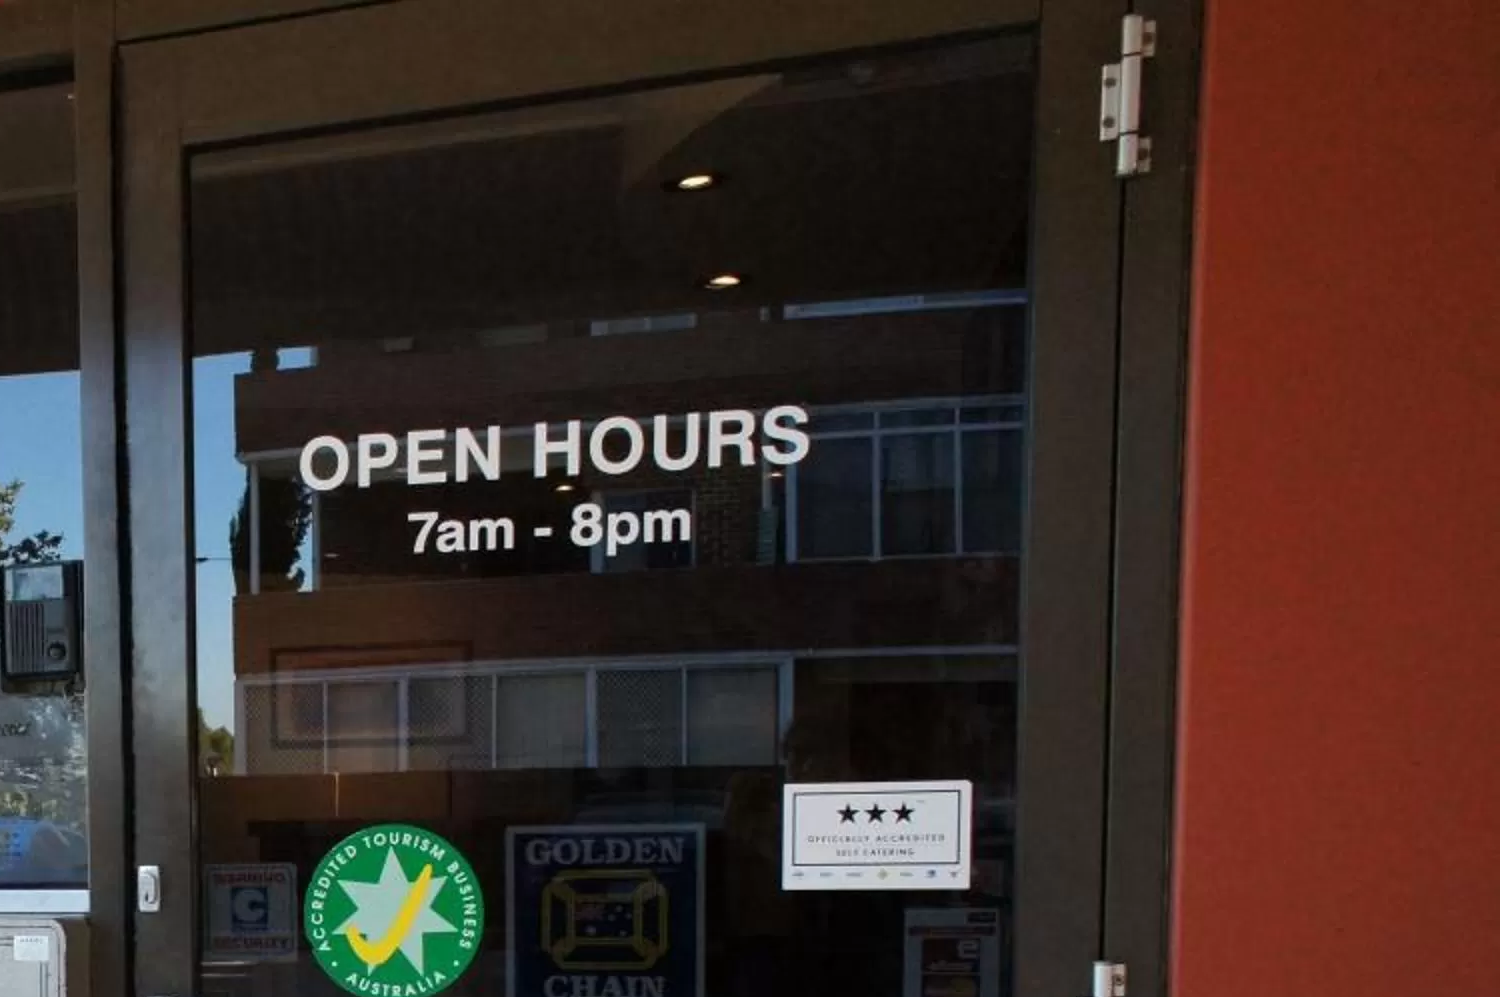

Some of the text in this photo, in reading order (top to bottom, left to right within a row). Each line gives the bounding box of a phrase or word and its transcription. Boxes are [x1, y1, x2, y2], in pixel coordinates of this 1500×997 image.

[299, 405, 811, 491] OPEN HOURS
[407, 503, 692, 556] 7am - 8pm
[525, 837, 685, 865] GOLDEN
[863, 847, 916, 857] CATERING
[876, 833, 945, 843] ACCREDITED
[311, 832, 477, 952] ACCREDITED TOURISM BUSINESS
[345, 971, 446, 997] AUSTRALIA
